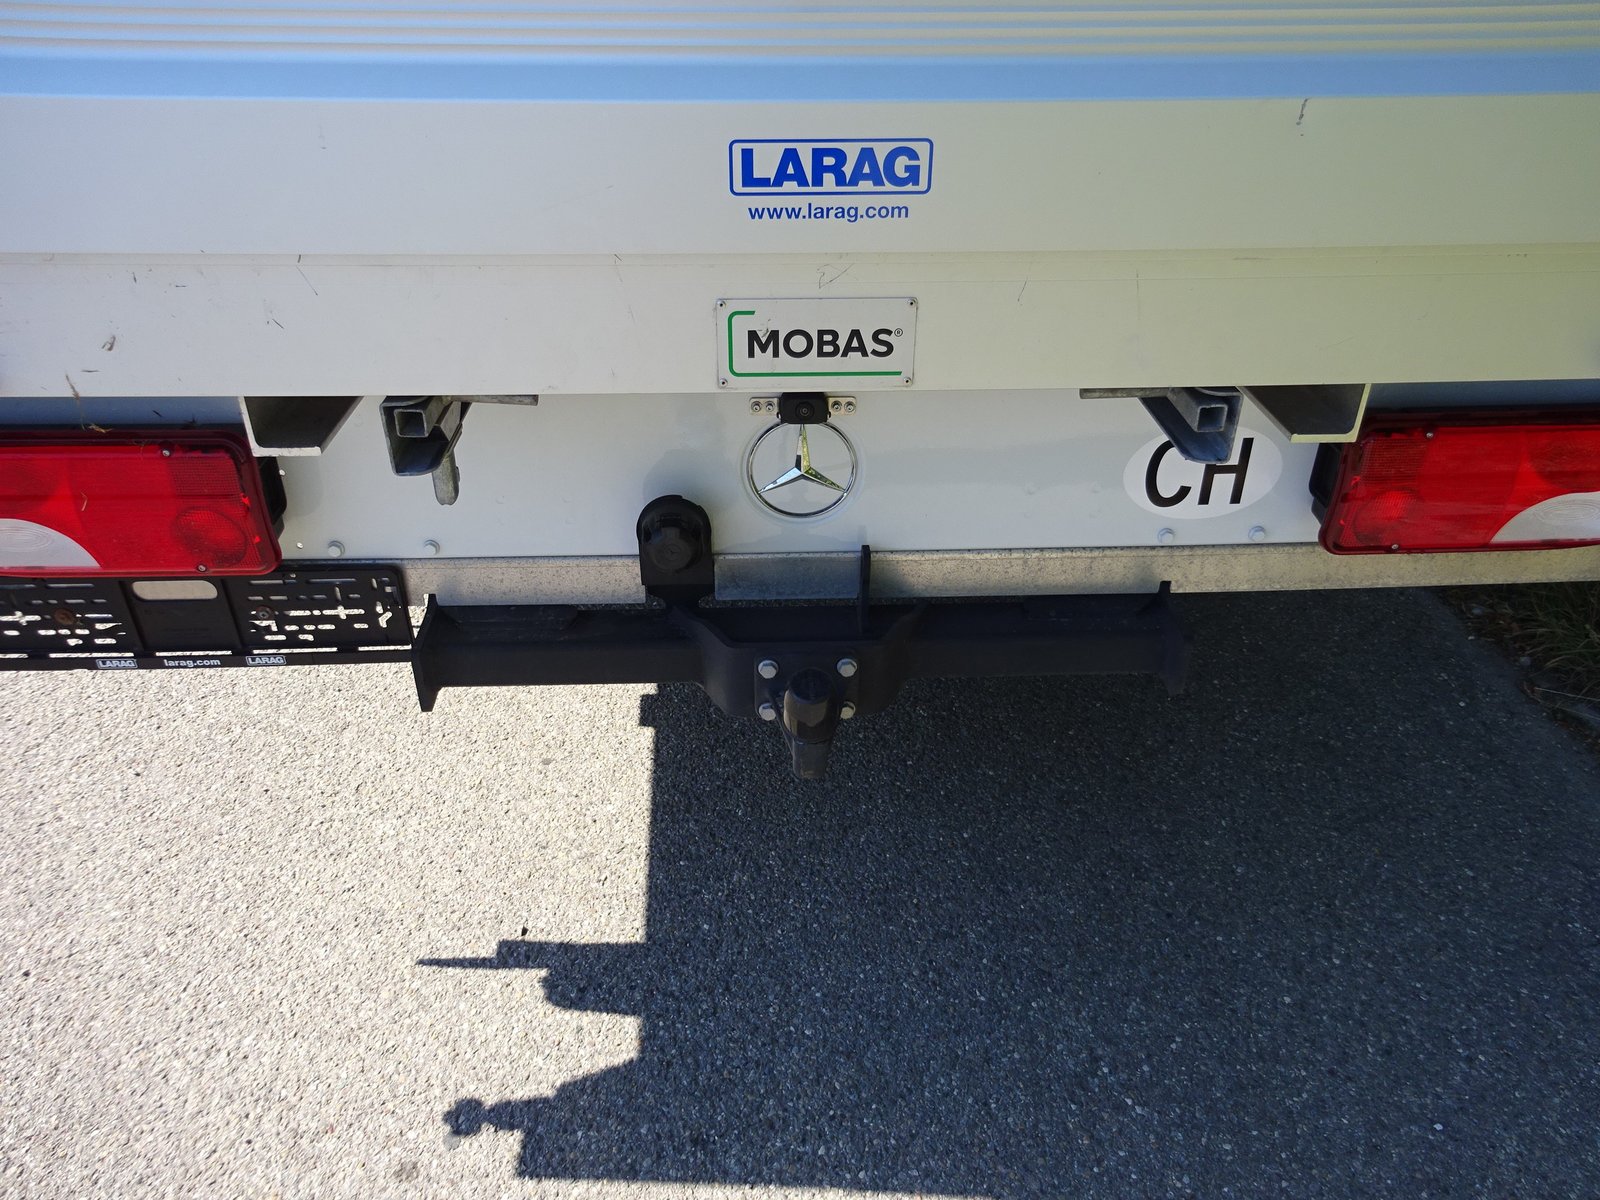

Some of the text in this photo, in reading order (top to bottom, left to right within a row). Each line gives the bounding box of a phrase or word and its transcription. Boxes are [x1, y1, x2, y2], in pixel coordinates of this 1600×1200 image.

[741, 146, 920, 188] LARAG
[748, 203, 909, 223] www.larag.com
[1145, 437, 1254, 507] CH
[97, 656, 285, 668] LARAG larag.com LARAG
